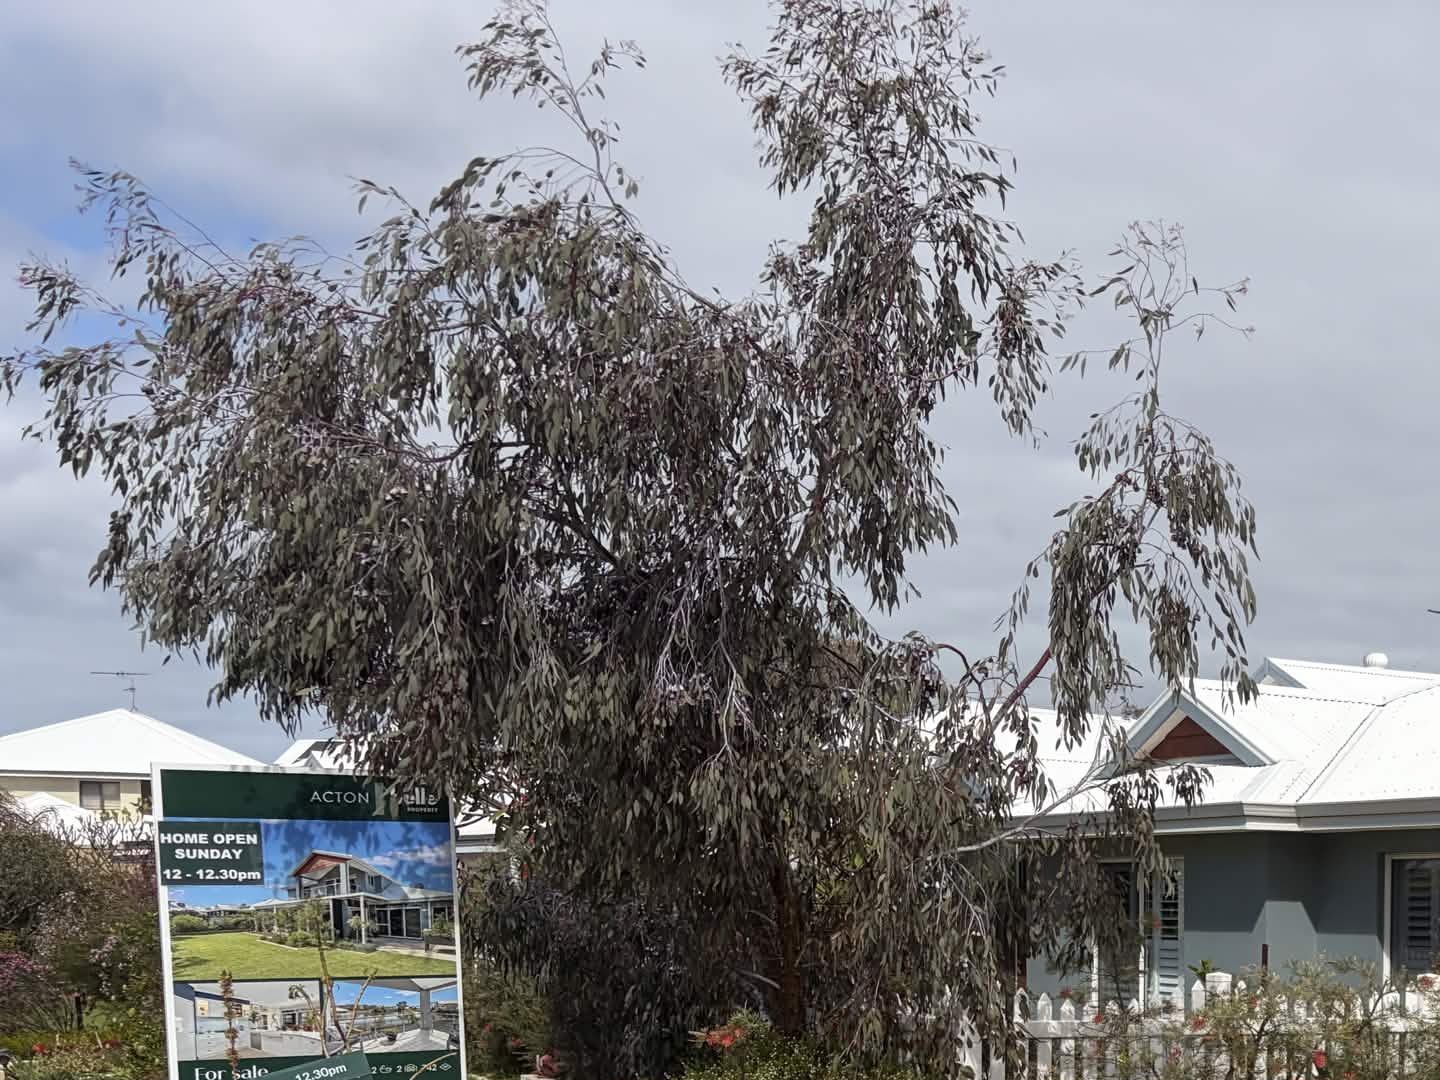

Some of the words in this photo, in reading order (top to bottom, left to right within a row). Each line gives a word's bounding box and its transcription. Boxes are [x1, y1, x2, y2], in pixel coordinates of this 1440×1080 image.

[310, 791, 369, 804] ACTON
[160, 833, 209, 845] HOME
[213, 833, 258, 845] OPEN
[174, 848, 243, 860] SUNDAY
[163, 868, 183, 880] 12
[196, 868, 261, 882] 12.30pm
[371, 1066, 378, 1074] 2
[396, 1065, 403, 1073] 2
